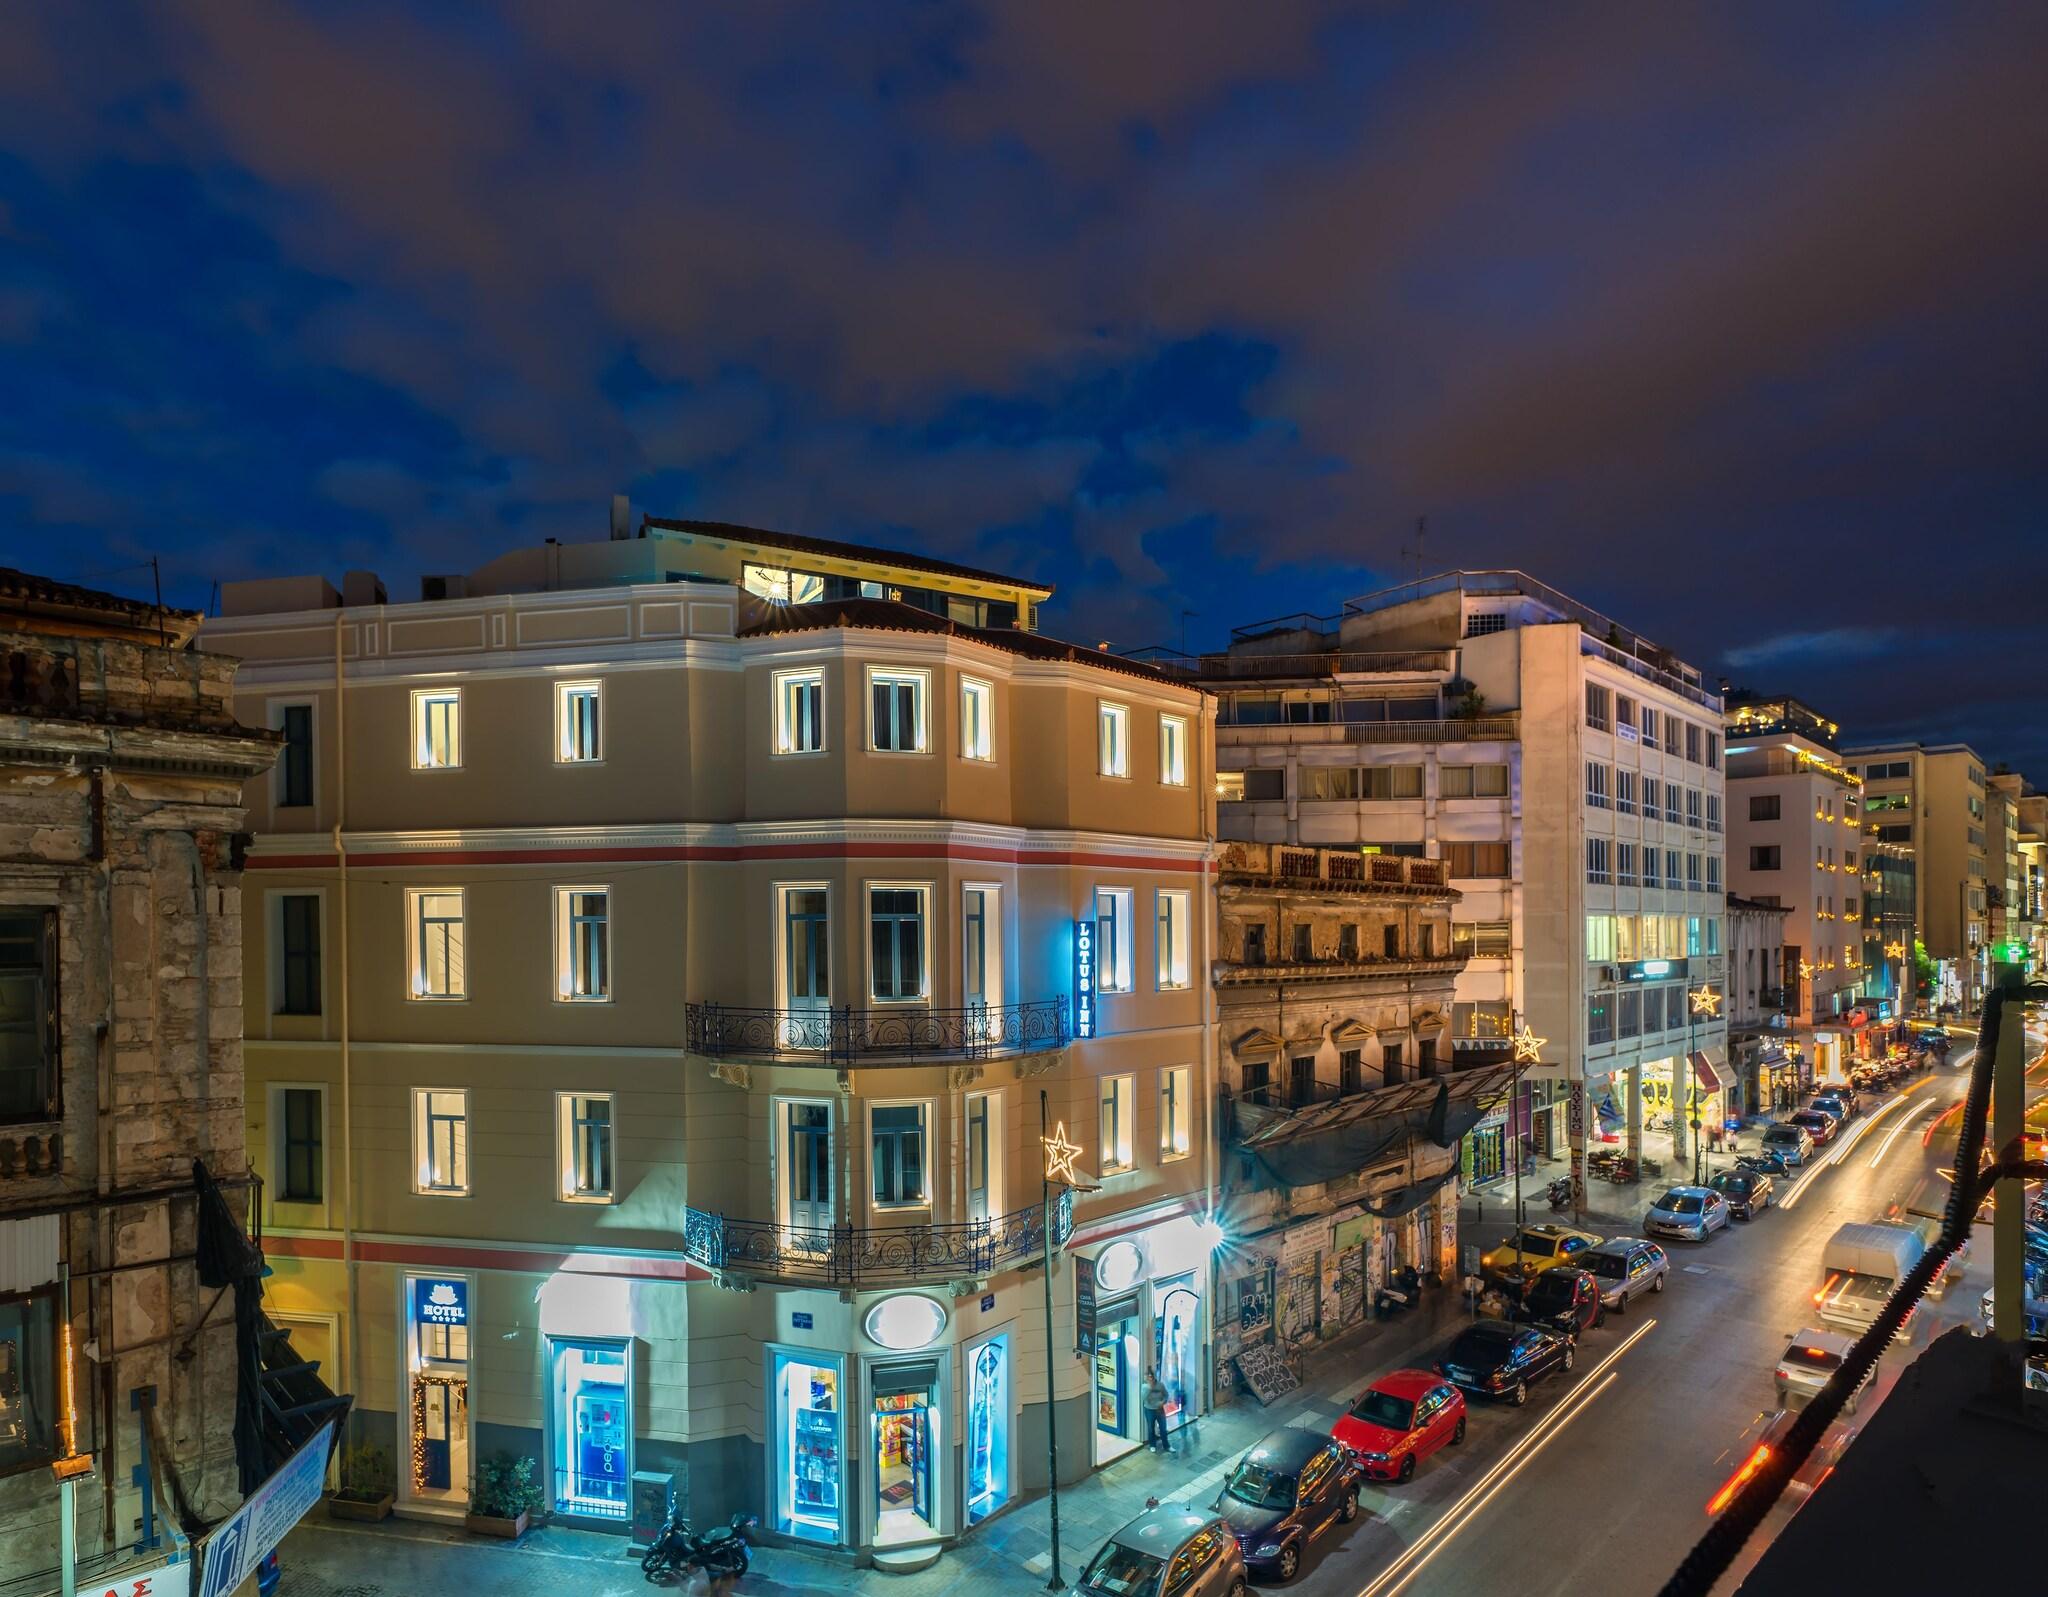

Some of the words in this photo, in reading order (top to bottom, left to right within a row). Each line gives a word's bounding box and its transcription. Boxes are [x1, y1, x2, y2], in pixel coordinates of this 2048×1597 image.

[1079, 923, 1090, 991] LOTUS
[1080, 996, 1090, 1037] INN
[1571, 1084, 1581, 1130] ΠΛΥΣΙΜΟ
[423, 1304, 465, 1317] HOTEL
